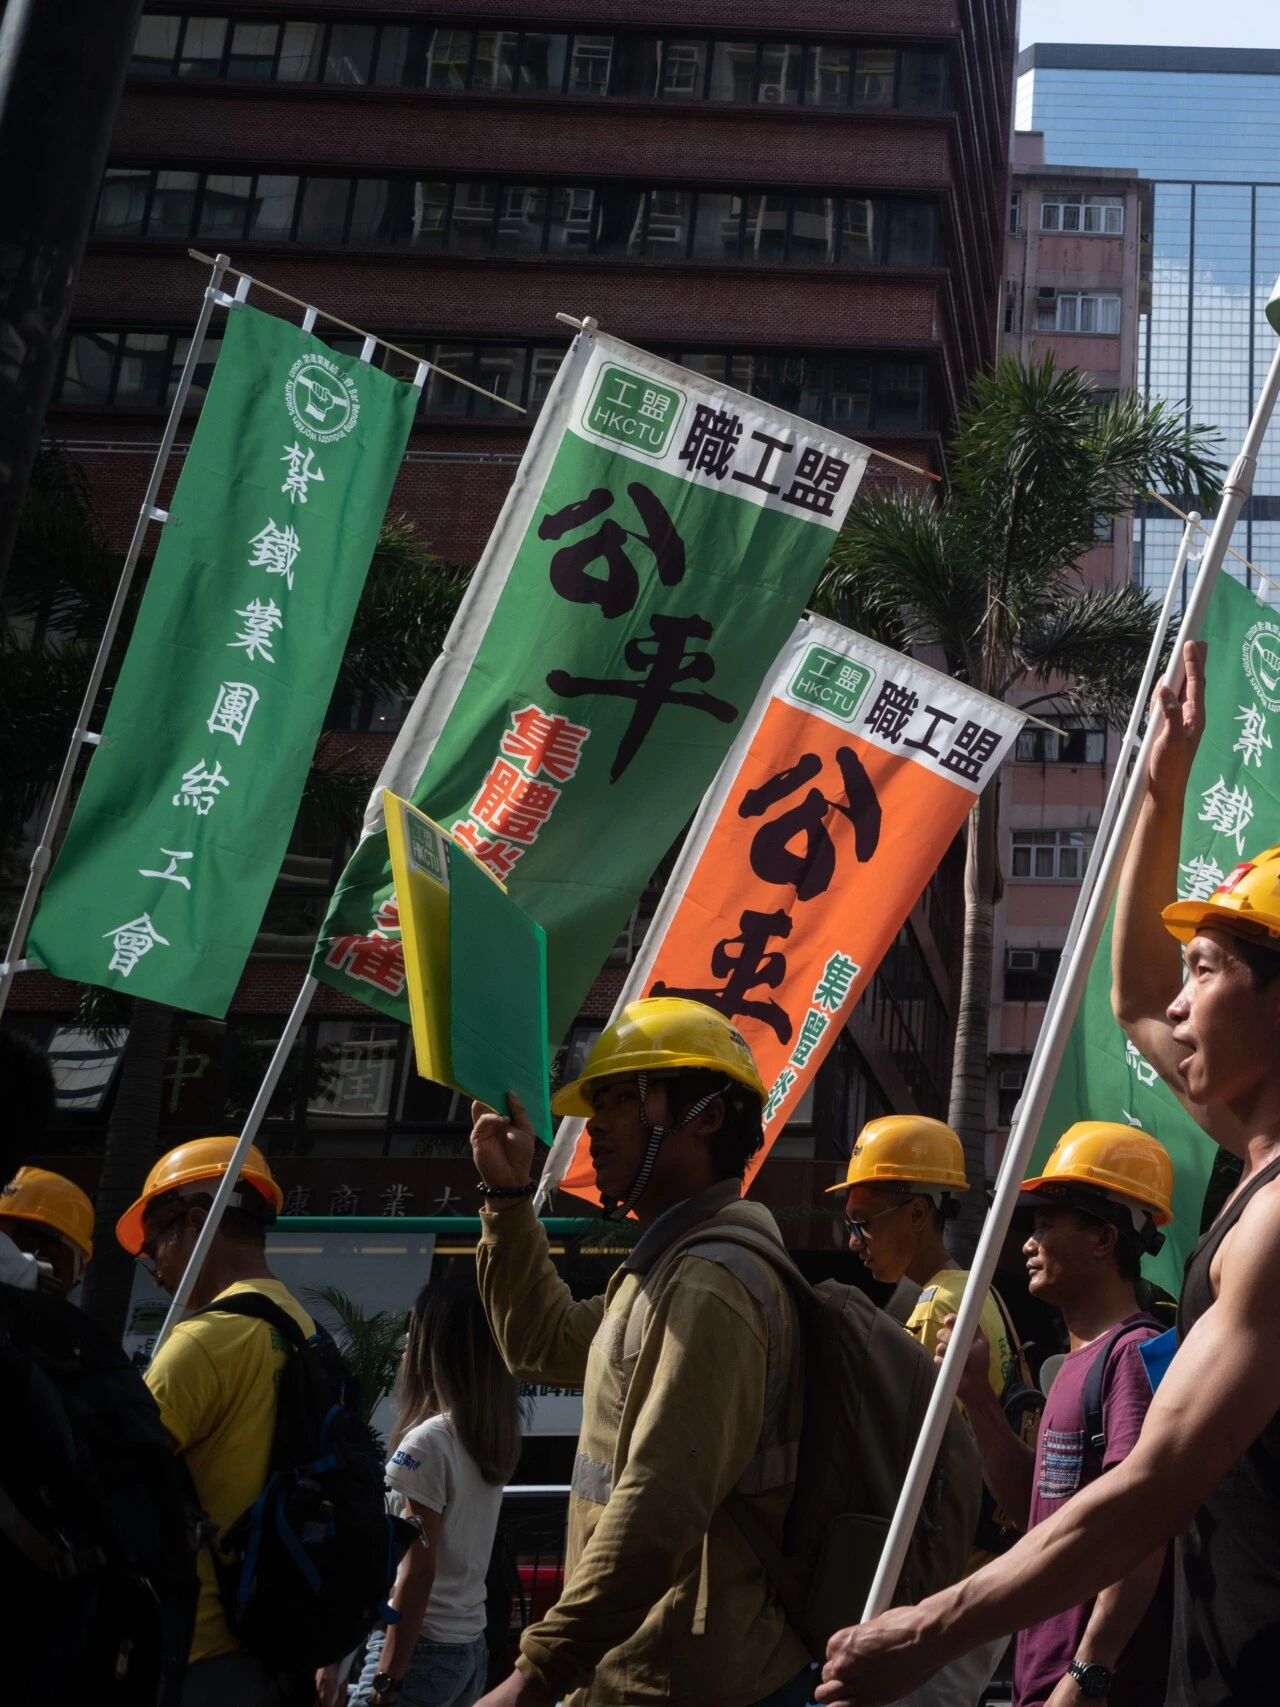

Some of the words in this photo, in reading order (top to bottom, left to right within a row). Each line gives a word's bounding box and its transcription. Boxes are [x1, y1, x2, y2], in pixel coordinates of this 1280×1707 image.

[288, 358, 303, 378] Union
[284, 379, 295, 416] Solidarity
[605, 377, 672, 423] 工盟
[292, 415, 317, 441] Workers
[593, 405, 666, 446] HKCTU
[678, 403, 849, 517] 職工盟
[538, 482, 739, 785] 公平
[807, 654, 864, 693] 工盟
[797, 677, 853, 712] HKCTU
[863, 679, 1003, 783] 職工盟
[412, 840, 440, 873] HKCTU
[648, 745, 883, 1046] 公平
